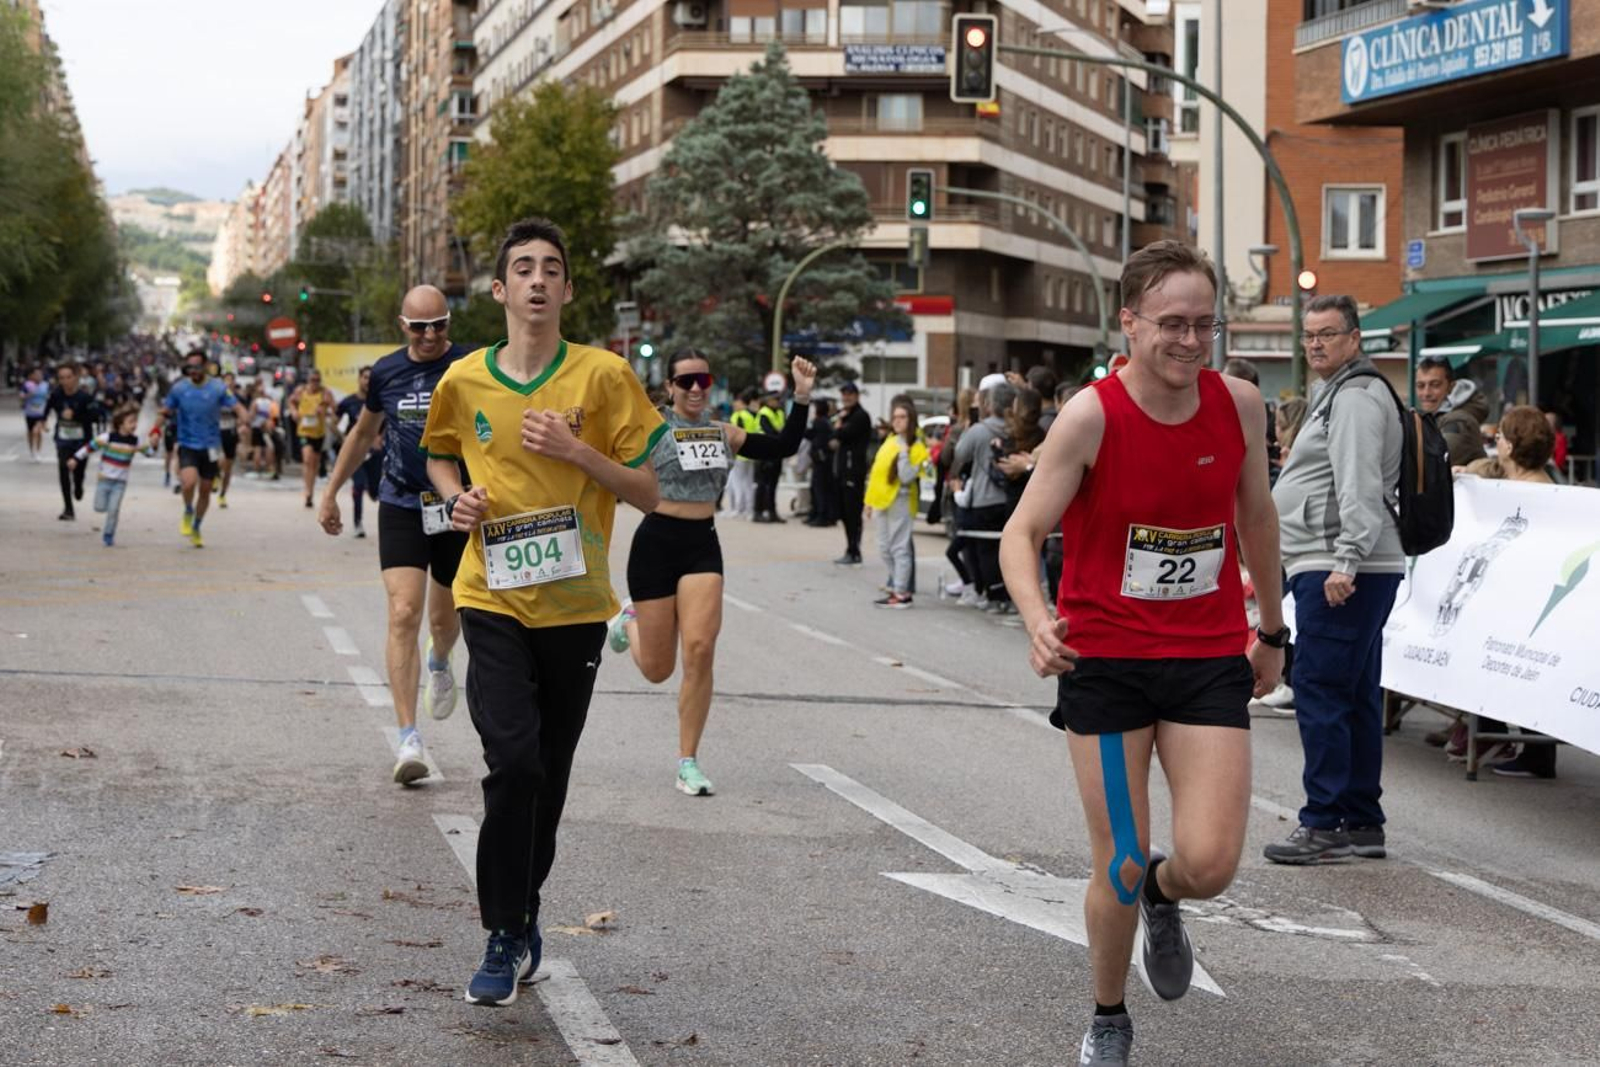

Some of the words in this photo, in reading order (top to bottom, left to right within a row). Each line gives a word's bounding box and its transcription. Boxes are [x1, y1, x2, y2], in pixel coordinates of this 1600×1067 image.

[1370, 23, 1440, 69] CLÍNICA
[1443, 1, 1523, 52] DENTAL
[689, 443, 719, 459] 122
[487, 522, 507, 538] XXV
[505, 536, 563, 571] 904
[1156, 557, 1196, 584] 22
[1481, 655, 1508, 676] Deportes
[1510, 662, 1523, 677] de
[1515, 644, 1550, 665] Municipal
[1548, 653, 1561, 667] de
